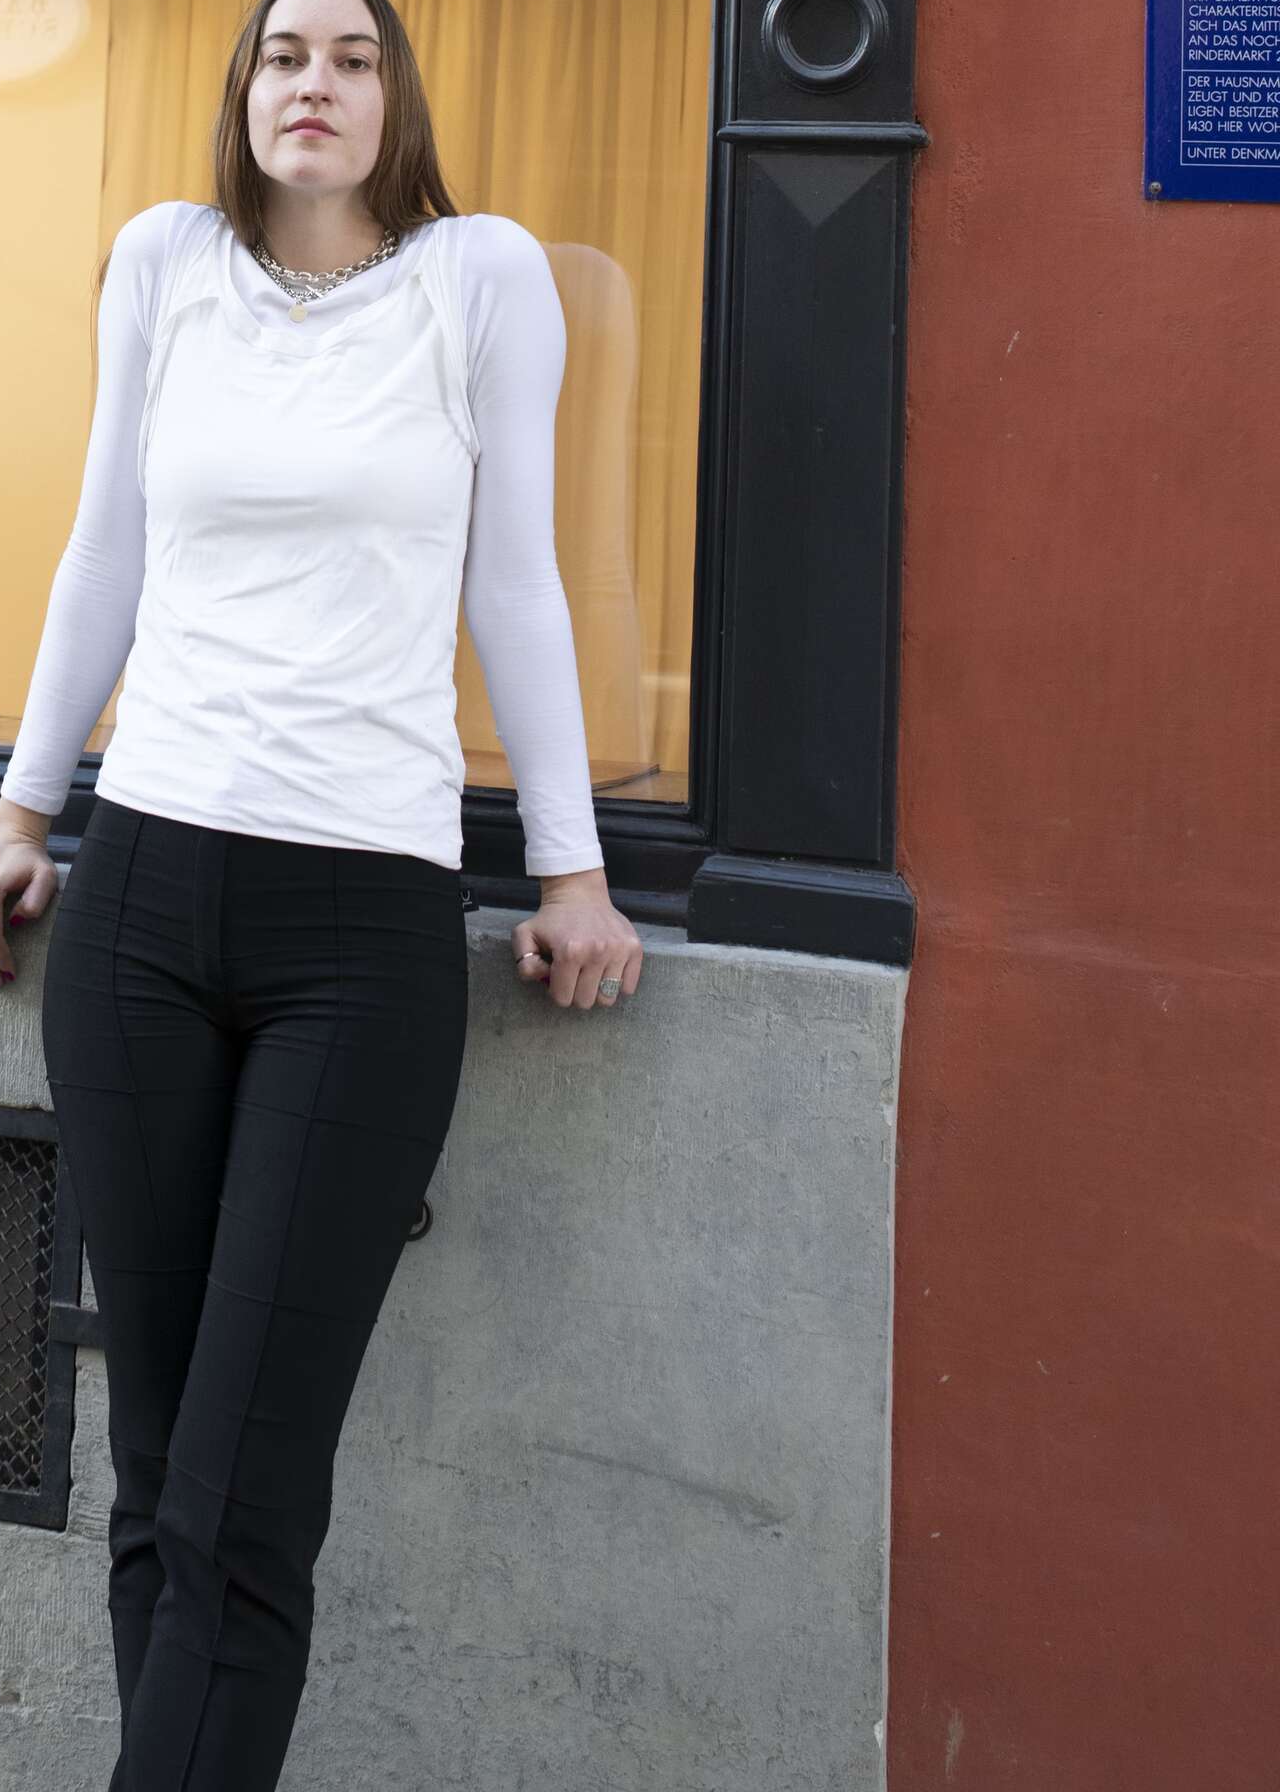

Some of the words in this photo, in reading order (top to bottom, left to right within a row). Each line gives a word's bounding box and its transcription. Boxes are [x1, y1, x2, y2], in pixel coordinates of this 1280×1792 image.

[1189, 20, 1218, 32] SICH
[1223, 20, 1247, 32] DAS
[1189, 35, 1208, 46] AN
[1214, 35, 1238, 46] DAS
[1243, 35, 1280, 47] NOCH
[1189, 50, 1272, 61] RINDERMARKT
[1188, 76, 1210, 87] DER
[1188, 91, 1228, 102] ZEUGT
[1232, 91, 1262, 103] UND
[1188, 106, 1223, 117] LIGEN
[1229, 107, 1279, 118] BESITZER
[1188, 121, 1213, 132] 1430
[1218, 121, 1243, 132] HIER
[1188, 147, 1226, 159] UNTER
